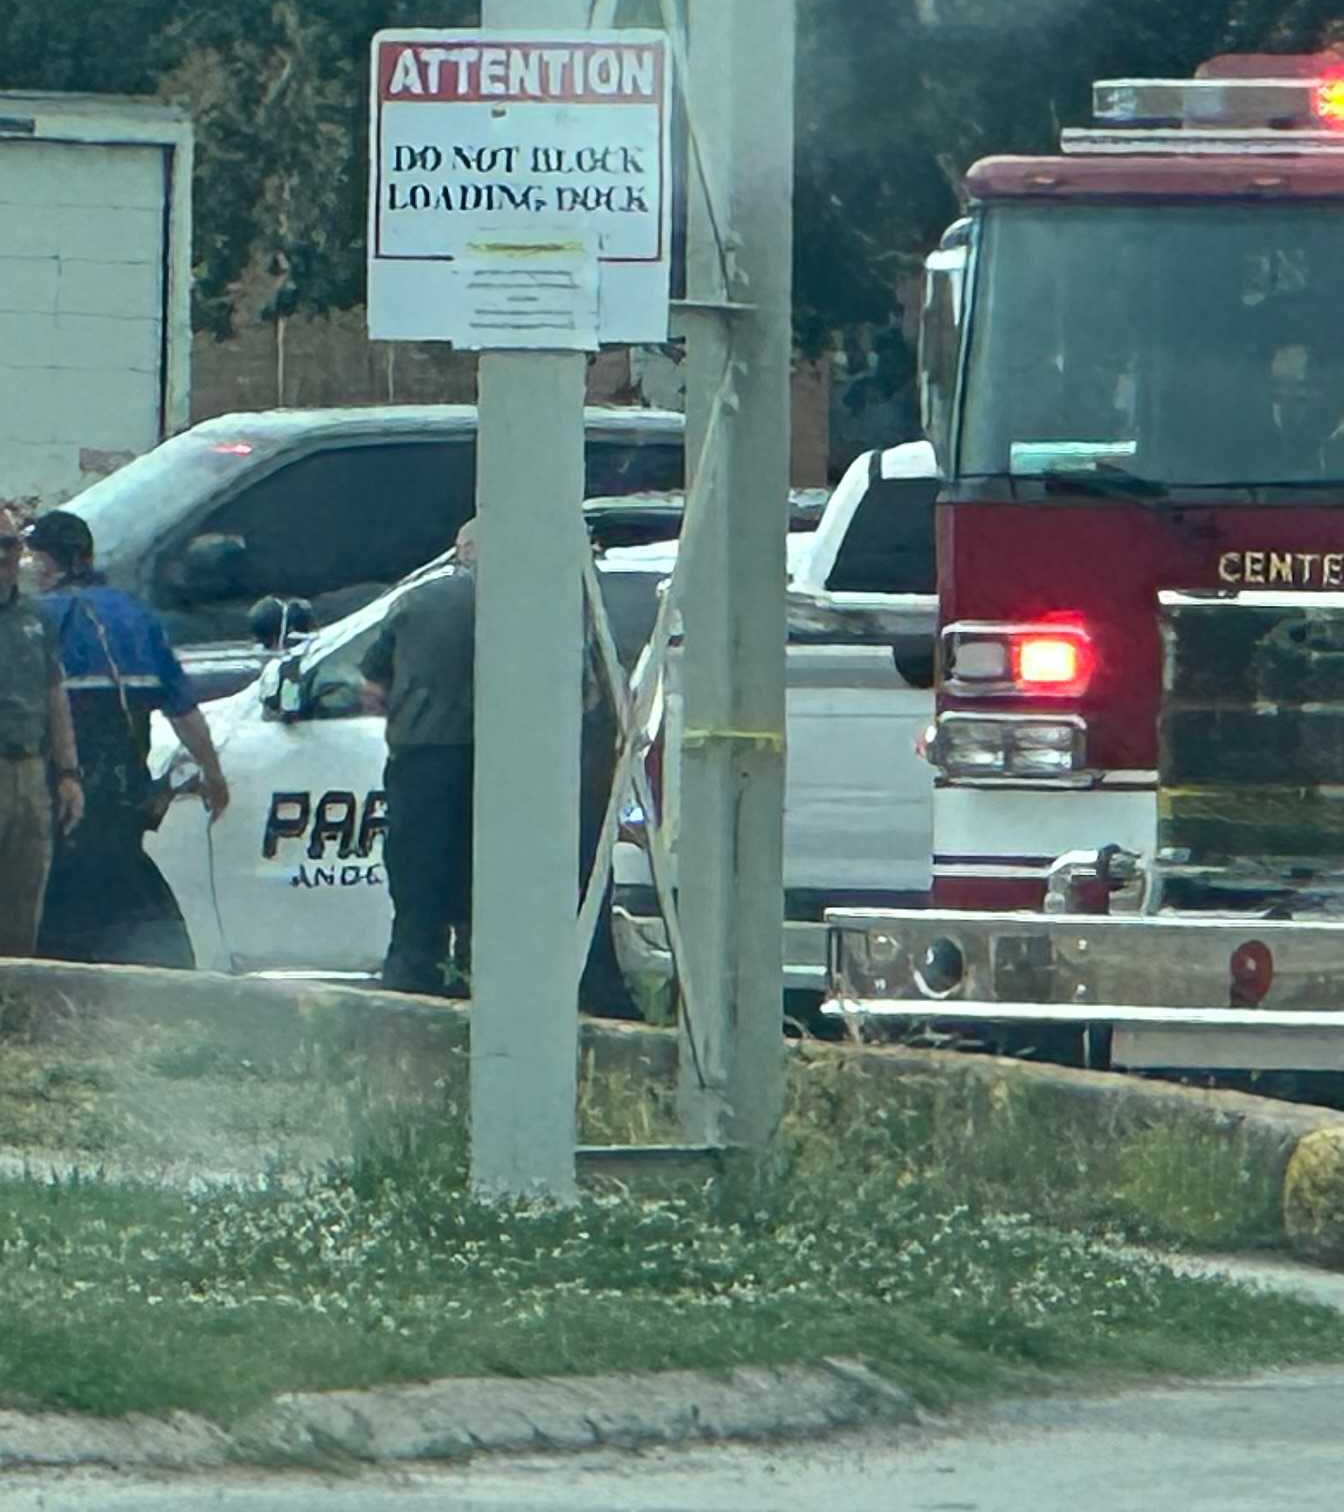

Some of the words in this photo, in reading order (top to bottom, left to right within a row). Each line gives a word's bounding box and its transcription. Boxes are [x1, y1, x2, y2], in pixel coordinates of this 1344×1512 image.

[388, 48, 654, 96] ATTENTION
[392, 145, 442, 173] DO
[452, 145, 519, 173] NOT
[530, 145, 645, 174] BLOCK
[388, 184, 547, 212] LOADING
[555, 186, 649, 213] DOCK
